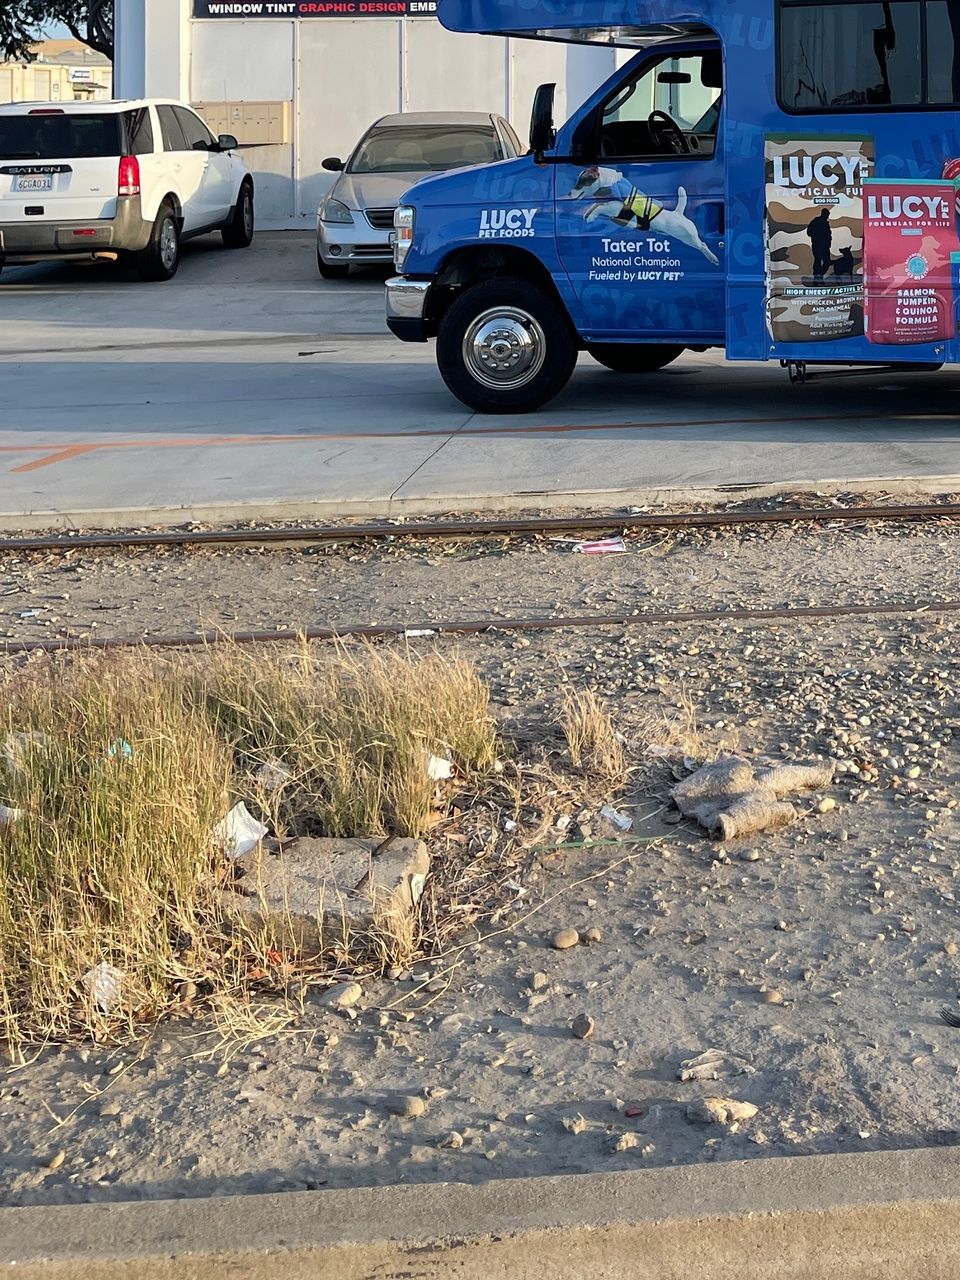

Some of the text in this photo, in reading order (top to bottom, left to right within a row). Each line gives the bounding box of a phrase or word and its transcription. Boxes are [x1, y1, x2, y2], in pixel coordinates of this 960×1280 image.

[208, 4, 262, 13] WINDOW
[266, 4, 295, 12] TINT
[299, 3, 355, 12] GRAPHIC
[359, 3, 406, 12] DESIGN
[9, 166, 60, 174] SATURN
[774, 156, 860, 186] LUCY
[860, 161, 868, 185] ET
[19, 180, 52, 189] 6CGA031
[776, 188, 836, 196] TACTICAL
[868, 196, 941, 218] LUCY
[480, 209, 537, 229] LUCY
[500, 229, 534, 237] FOODS
[602, 239, 670, 252] Tater Tot
[592, 257, 680, 268] National Champion
[590, 271, 621, 280] Fueled
[624, 271, 635, 281] by
[638, 272, 661, 280] LUCY
[903, 306, 938, 315] QUINOA
[896, 316, 937, 324] FORMULA
